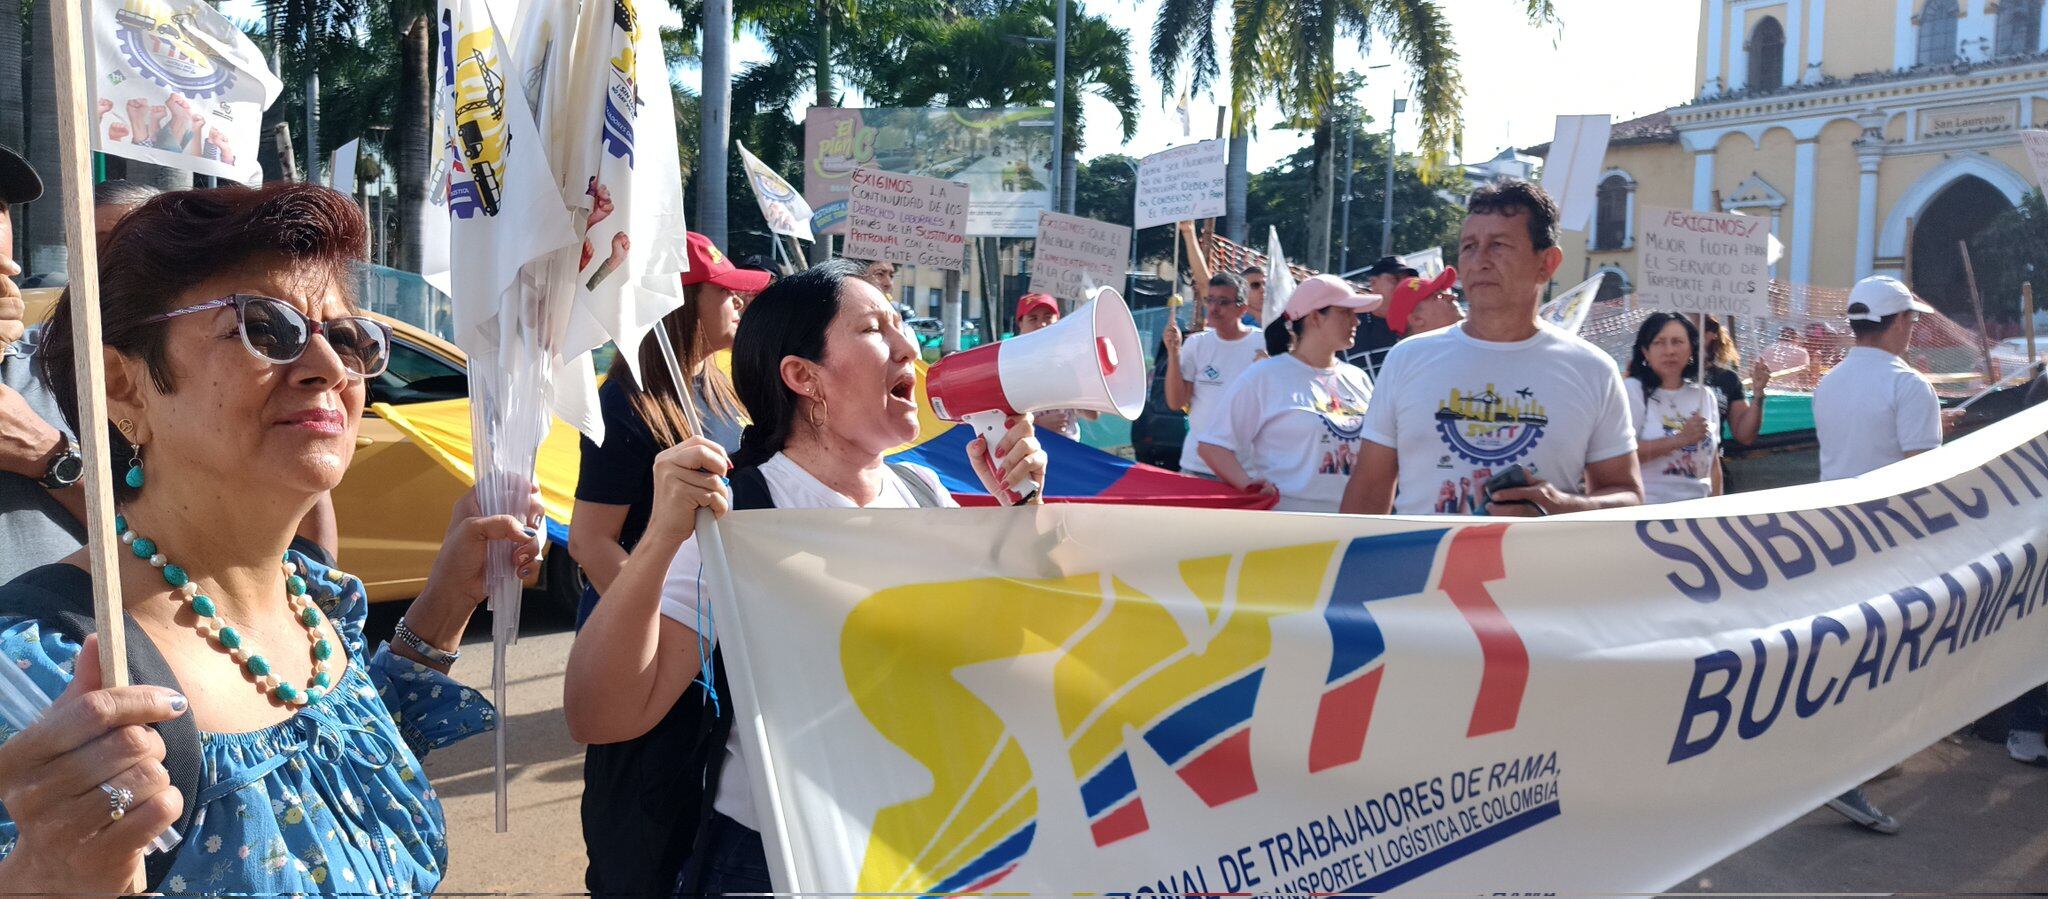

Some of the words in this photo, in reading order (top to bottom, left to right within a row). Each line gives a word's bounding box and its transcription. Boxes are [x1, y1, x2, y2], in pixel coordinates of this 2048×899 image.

[1934, 120, 1954, 130] San
[1955, 115, 2006, 128] Laureano
[851, 185, 924, 210] CONTINUIDAD
[928, 200, 942, 213] DE
[929, 184, 947, 198] LA
[852, 200, 896, 220] DERECHOS
[900, 212, 945, 227] LABORALES
[949, 220, 956, 230] A
[887, 223, 899, 234] DE
[850, 227, 899, 246] PATRONAL
[927, 242, 945, 253] EL
[1646, 232, 1687, 254] MEJOR
[1700, 238, 1738, 256] FLOTA
[884, 246, 913, 262] ENTE
[1644, 253, 1660, 270] EL
[1666, 257, 1732, 276] SERVICIO
[1740, 262, 1760, 276] DE
[1046, 266, 1058, 277] LA
[1712, 280, 1722, 292] A
[1730, 280, 1756, 294] LOS
[1670, 292, 1752, 314] USUARIOS
[1218, 846, 1262, 895] DE
[1259, 776, 1446, 876] TRABAJADORES
[1451, 766, 1484, 804] DE
[1487, 750, 1562, 792] RAMA,
[1364, 848, 1378, 874] Y
[1380, 814, 1460, 868] LOGÍSTICA
[1458, 806, 1482, 835] DE
[1481, 779, 1559, 825] COLOMBIA
